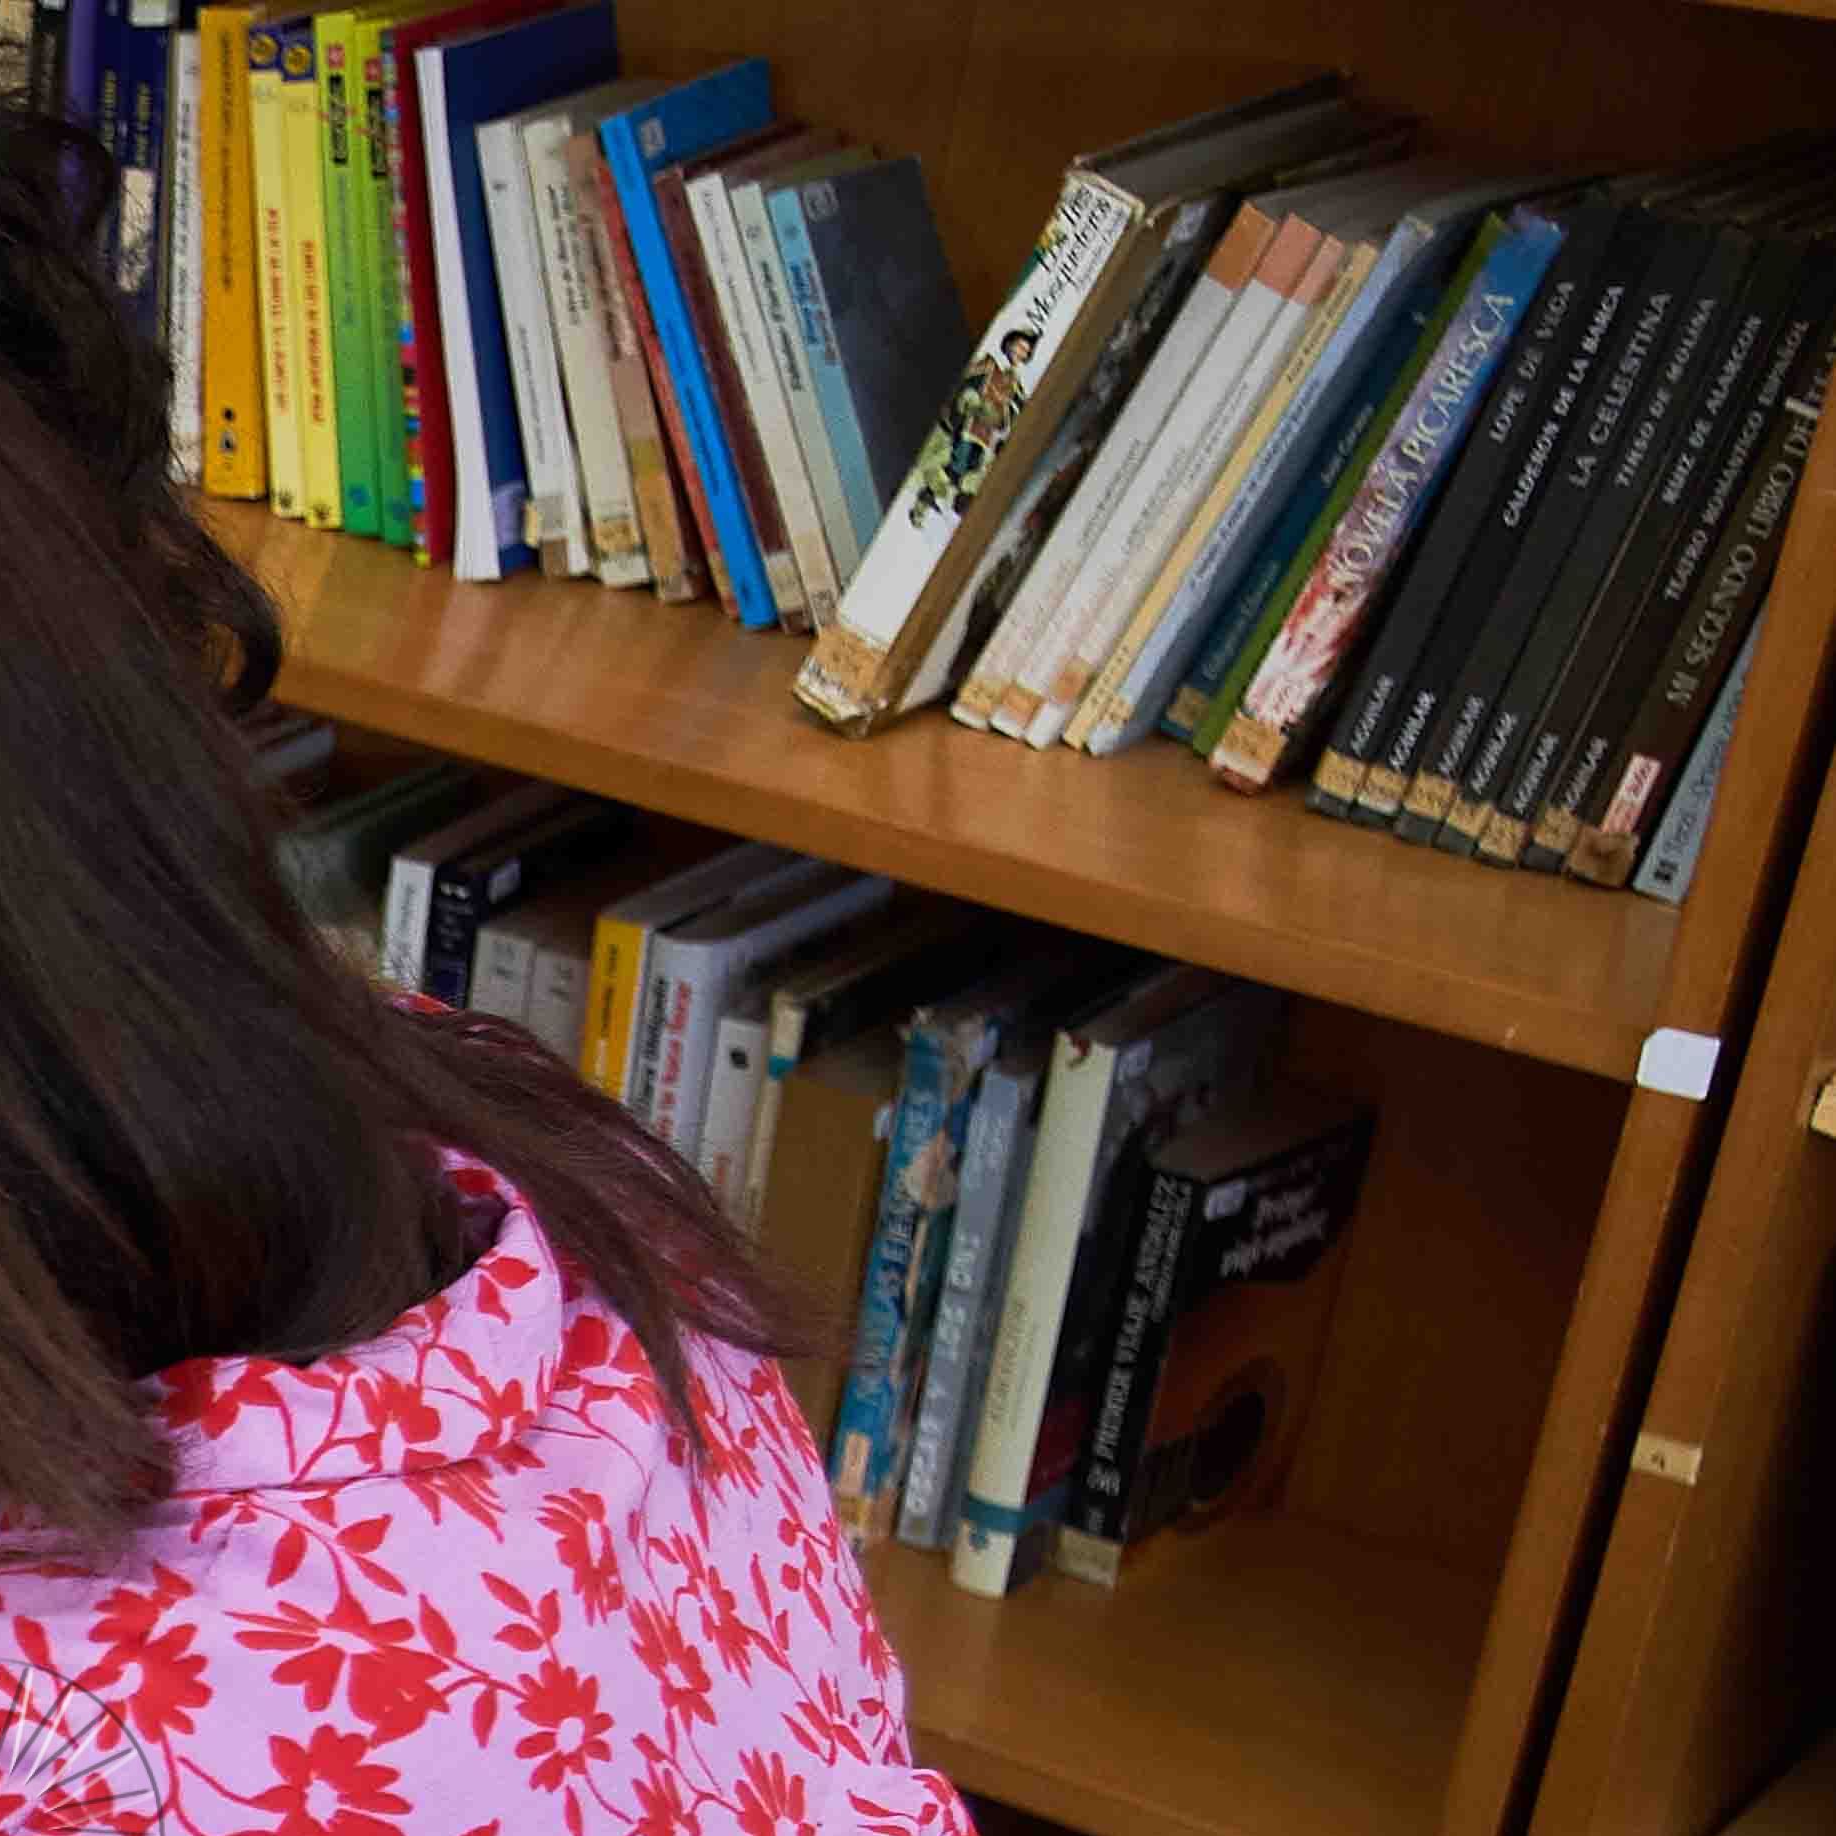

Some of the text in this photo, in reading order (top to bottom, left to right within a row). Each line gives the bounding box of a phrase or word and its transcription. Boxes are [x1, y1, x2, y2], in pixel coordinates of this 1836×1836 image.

[1401, 290, 1518, 458] PICARESCA
[1489, 282, 1575, 443] LOPE DE VEGA
[1552, 387, 1576, 417] DE
[1567, 359, 1589, 384] LA
[1581, 286, 1624, 354] BARCA
[1568, 294, 1671, 487] LA CELESTINA
[1615, 299, 1716, 487] TIRSO DE MOLINA
[1662, 453, 1696, 505] RUIZ
[1688, 419, 1712, 449] DE
[1664, 529, 1708, 601] TEATRO
[1666, 671, 1694, 708] MI
[1684, 542, 1757, 666] SEGUNDO
[1744, 460, 1796, 535] LIBRO
[1350, 675, 1394, 754] AGUILAR
[1390, 691, 1436, 769] AGUILAR
[1470, 711, 1518, 794] AGUILAR
[1512, 733, 1559, 813] AGUILAR
